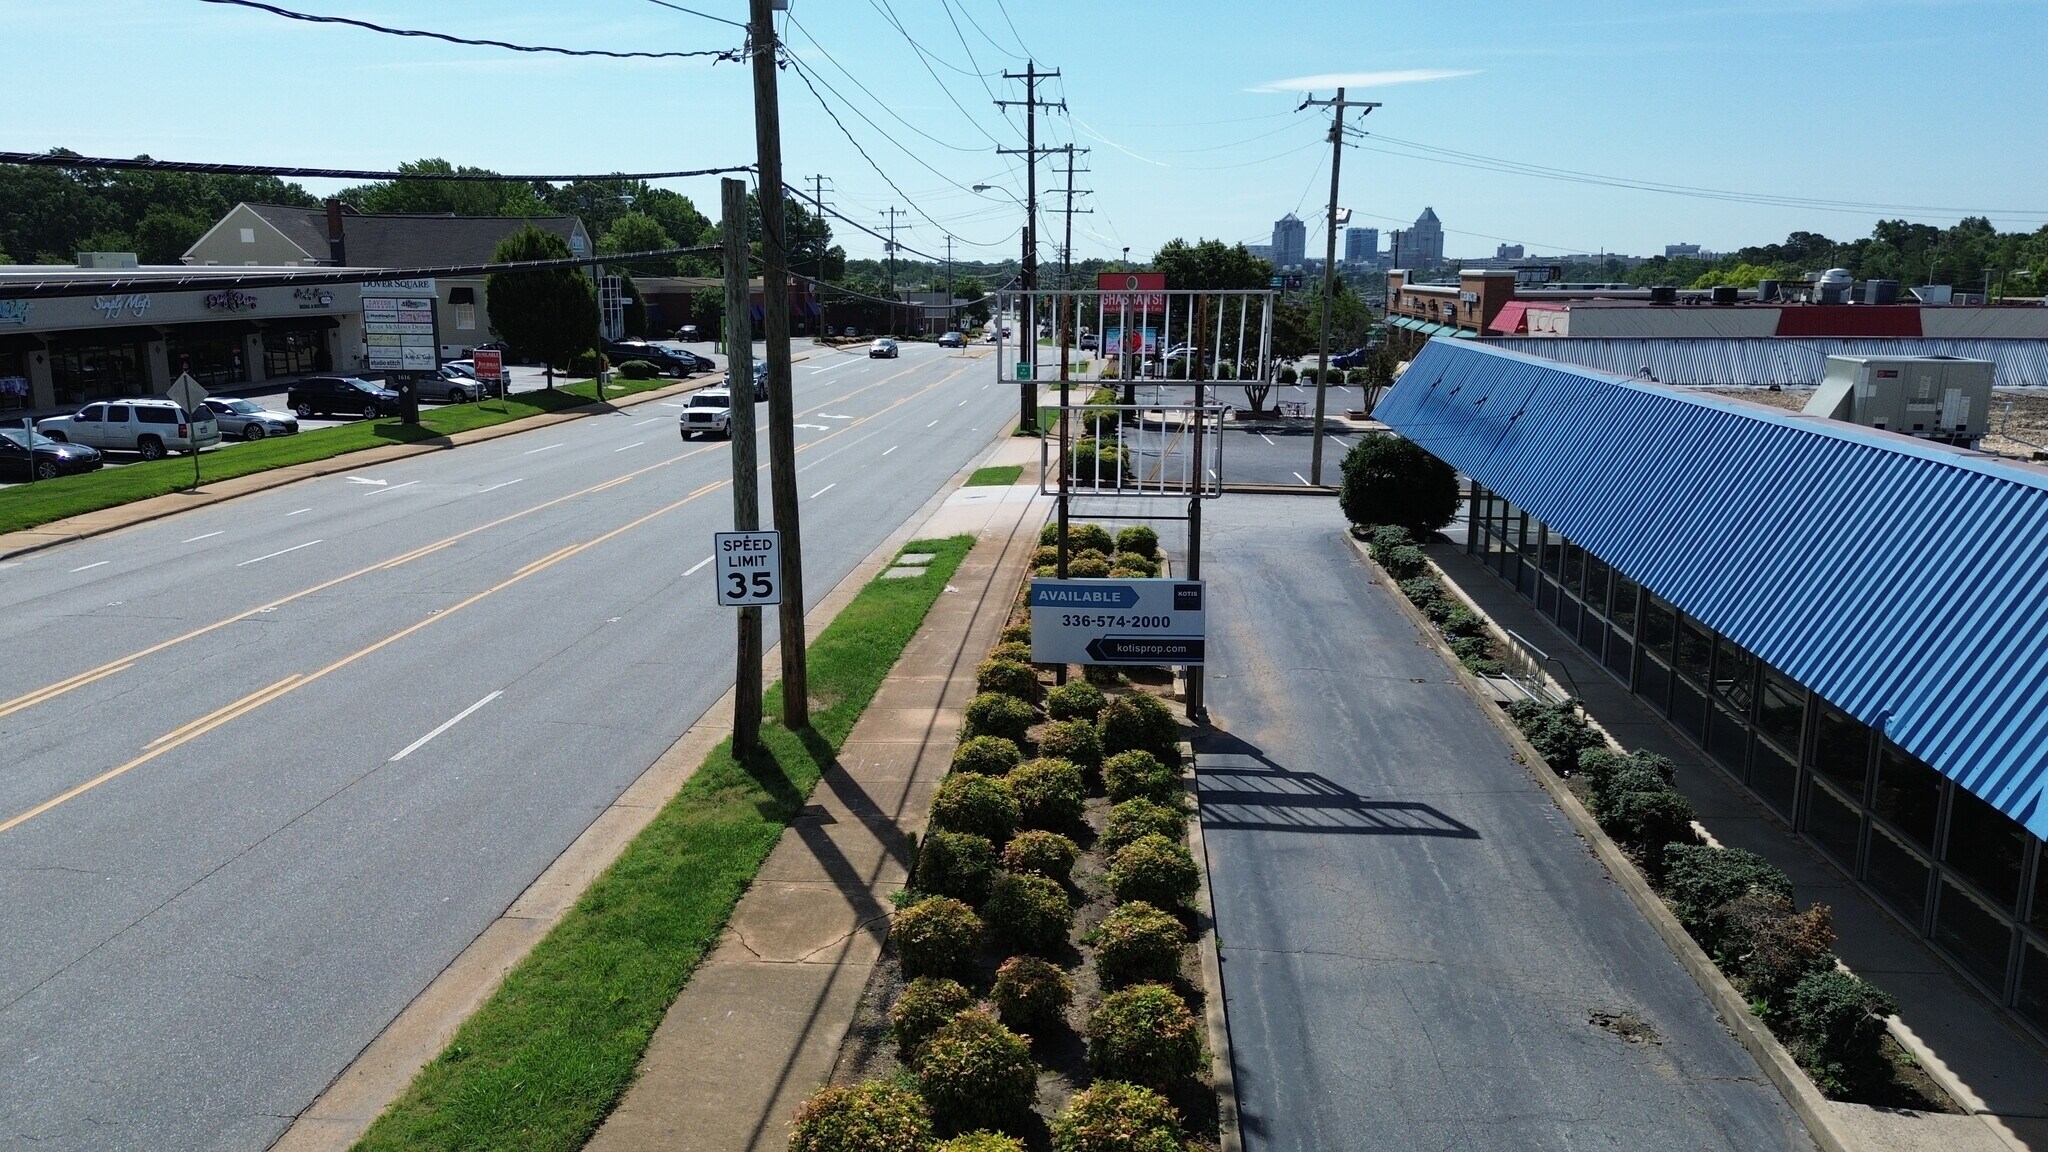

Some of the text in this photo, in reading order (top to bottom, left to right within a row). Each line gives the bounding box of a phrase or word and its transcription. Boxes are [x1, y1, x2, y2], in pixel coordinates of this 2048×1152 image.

[363, 280, 429, 289] DOVER SQUARE
[94, 295, 151, 318] Simply Meg's
[723, 539, 772, 551] SPEED
[728, 555, 767, 567] LIMIT
[726, 571, 773, 599] 35
[1038, 590, 1121, 602] AVAILABLE
[1062, 614, 1171, 628] 336-574-2000
[1117, 643, 1187, 655] kotisprop.com
